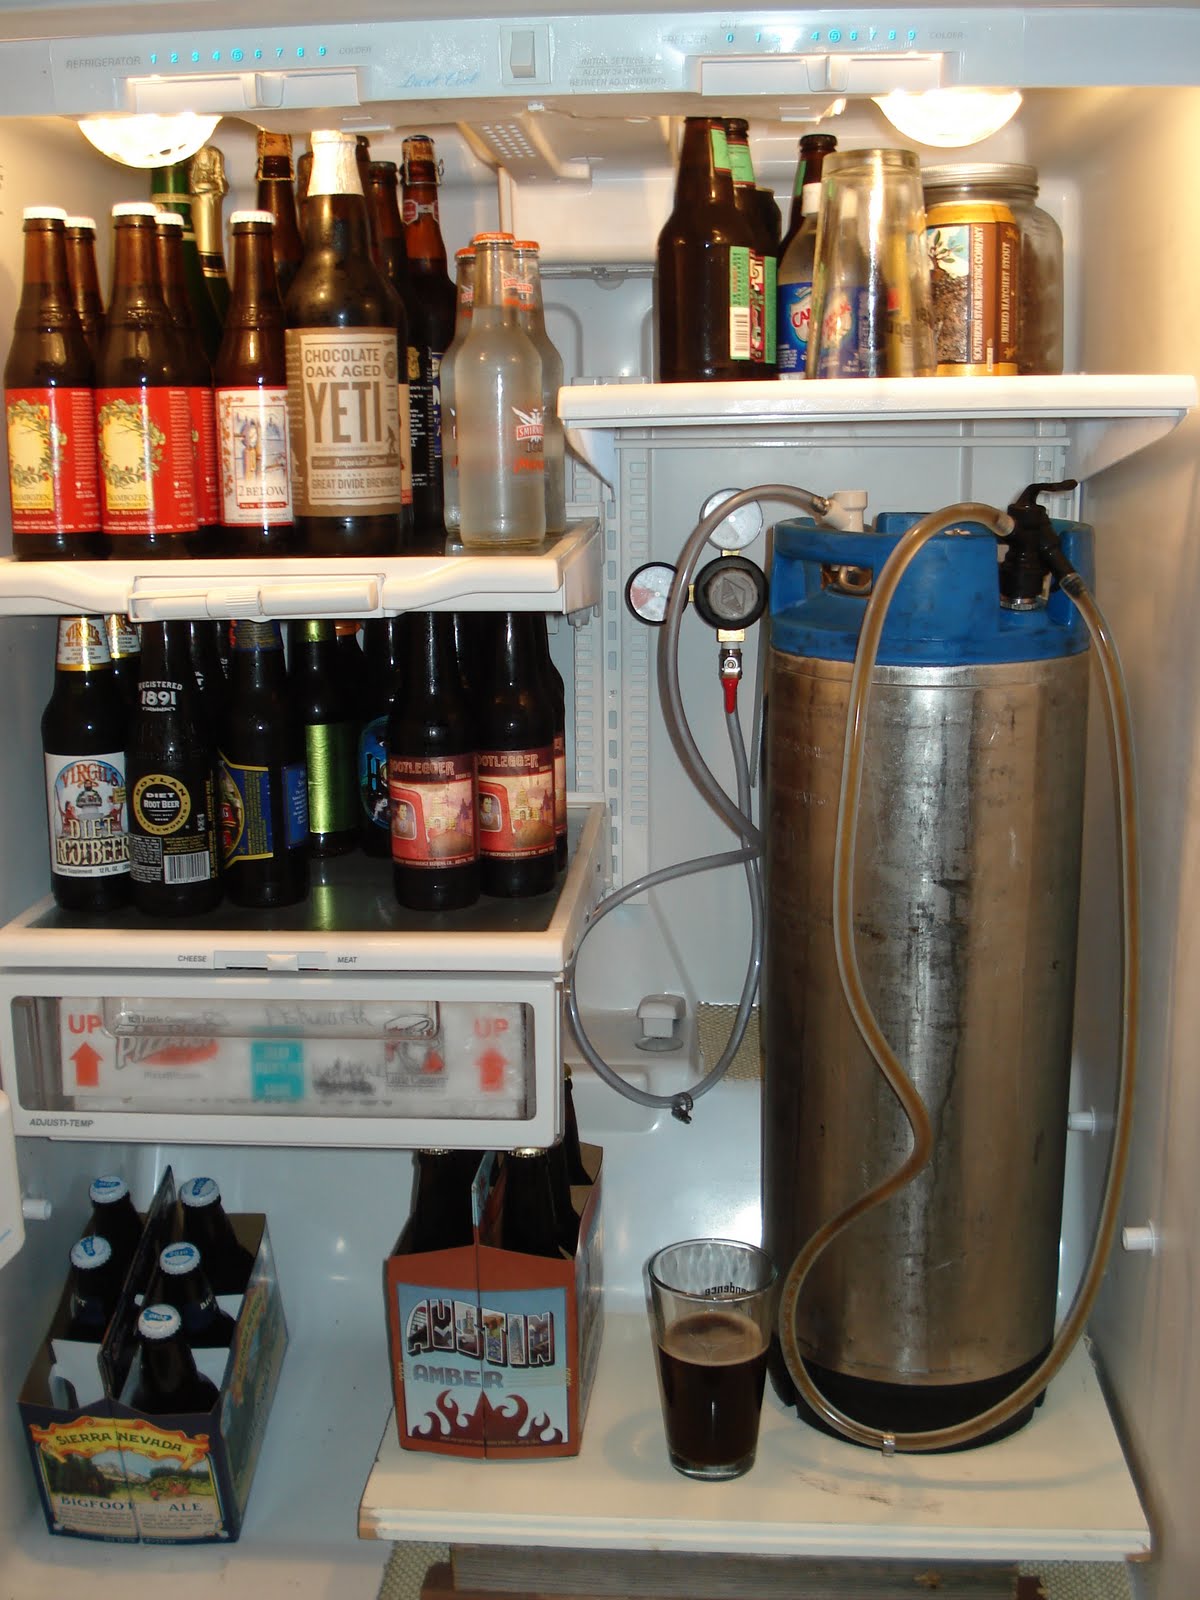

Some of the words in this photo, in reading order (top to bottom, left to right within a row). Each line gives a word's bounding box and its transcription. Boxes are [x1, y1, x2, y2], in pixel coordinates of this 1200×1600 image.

[811, 31, 819, 41] 4
[850, 31, 858, 41] 6
[888, 30, 897, 40] 8
[908, 30, 916, 40] 9
[66, 56, 141, 69] REFRIGERATOR
[151, 54, 157, 64] 1
[171, 53, 179, 63] 2
[191, 52, 199, 62] 3
[212, 51, 220, 61] 4
[232, 49, 242, 61] 5
[255, 49, 262, 59] 6
[276, 48, 283, 57] 7
[297, 47, 305, 57] 8
[319, 46, 326, 56] 9
[974, 226, 984, 264] COMPANY
[974, 264, 983, 298] BREWING
[974, 298, 983, 319] STAR
[973, 320, 983, 360] SOUTHERN
[305, 348, 380, 363] CHOCOLATE
[306, 366, 336, 378] OAK
[341, 365, 381, 378] AGED
[306, 381, 382, 443] YETI
[246, 486, 286, 496] BELOW
[312, 479, 336, 490] GREAT
[338, 479, 365, 489] DIVIDE
[138, 681, 183, 691] REGISTERED
[141, 690, 177, 706] 1891
[61, 763, 119, 788] VIRGIL'S
[135, 776, 187, 797] BOYLAN
[143, 799, 160, 808] ROOT
[161, 799, 180, 808] BEER
[68, 817, 115, 840] DIET
[177, 955, 207, 963] CHEESE
[337, 956, 357, 964] MEAT
[68, 1014, 103, 1034] UP
[474, 1018, 509, 1039] UP
[29, 1118, 95, 1128] ADJUSTI-TEMP
[406, 1298, 555, 1368] AUSTIN
[413, 1363, 505, 1388] AMBER
[56, 1431, 112, 1446] SIERRA
[116, 1430, 182, 1451] NEVADA
[61, 1496, 135, 1511] BIGFOOT
[169, 1503, 203, 1512] ALE
